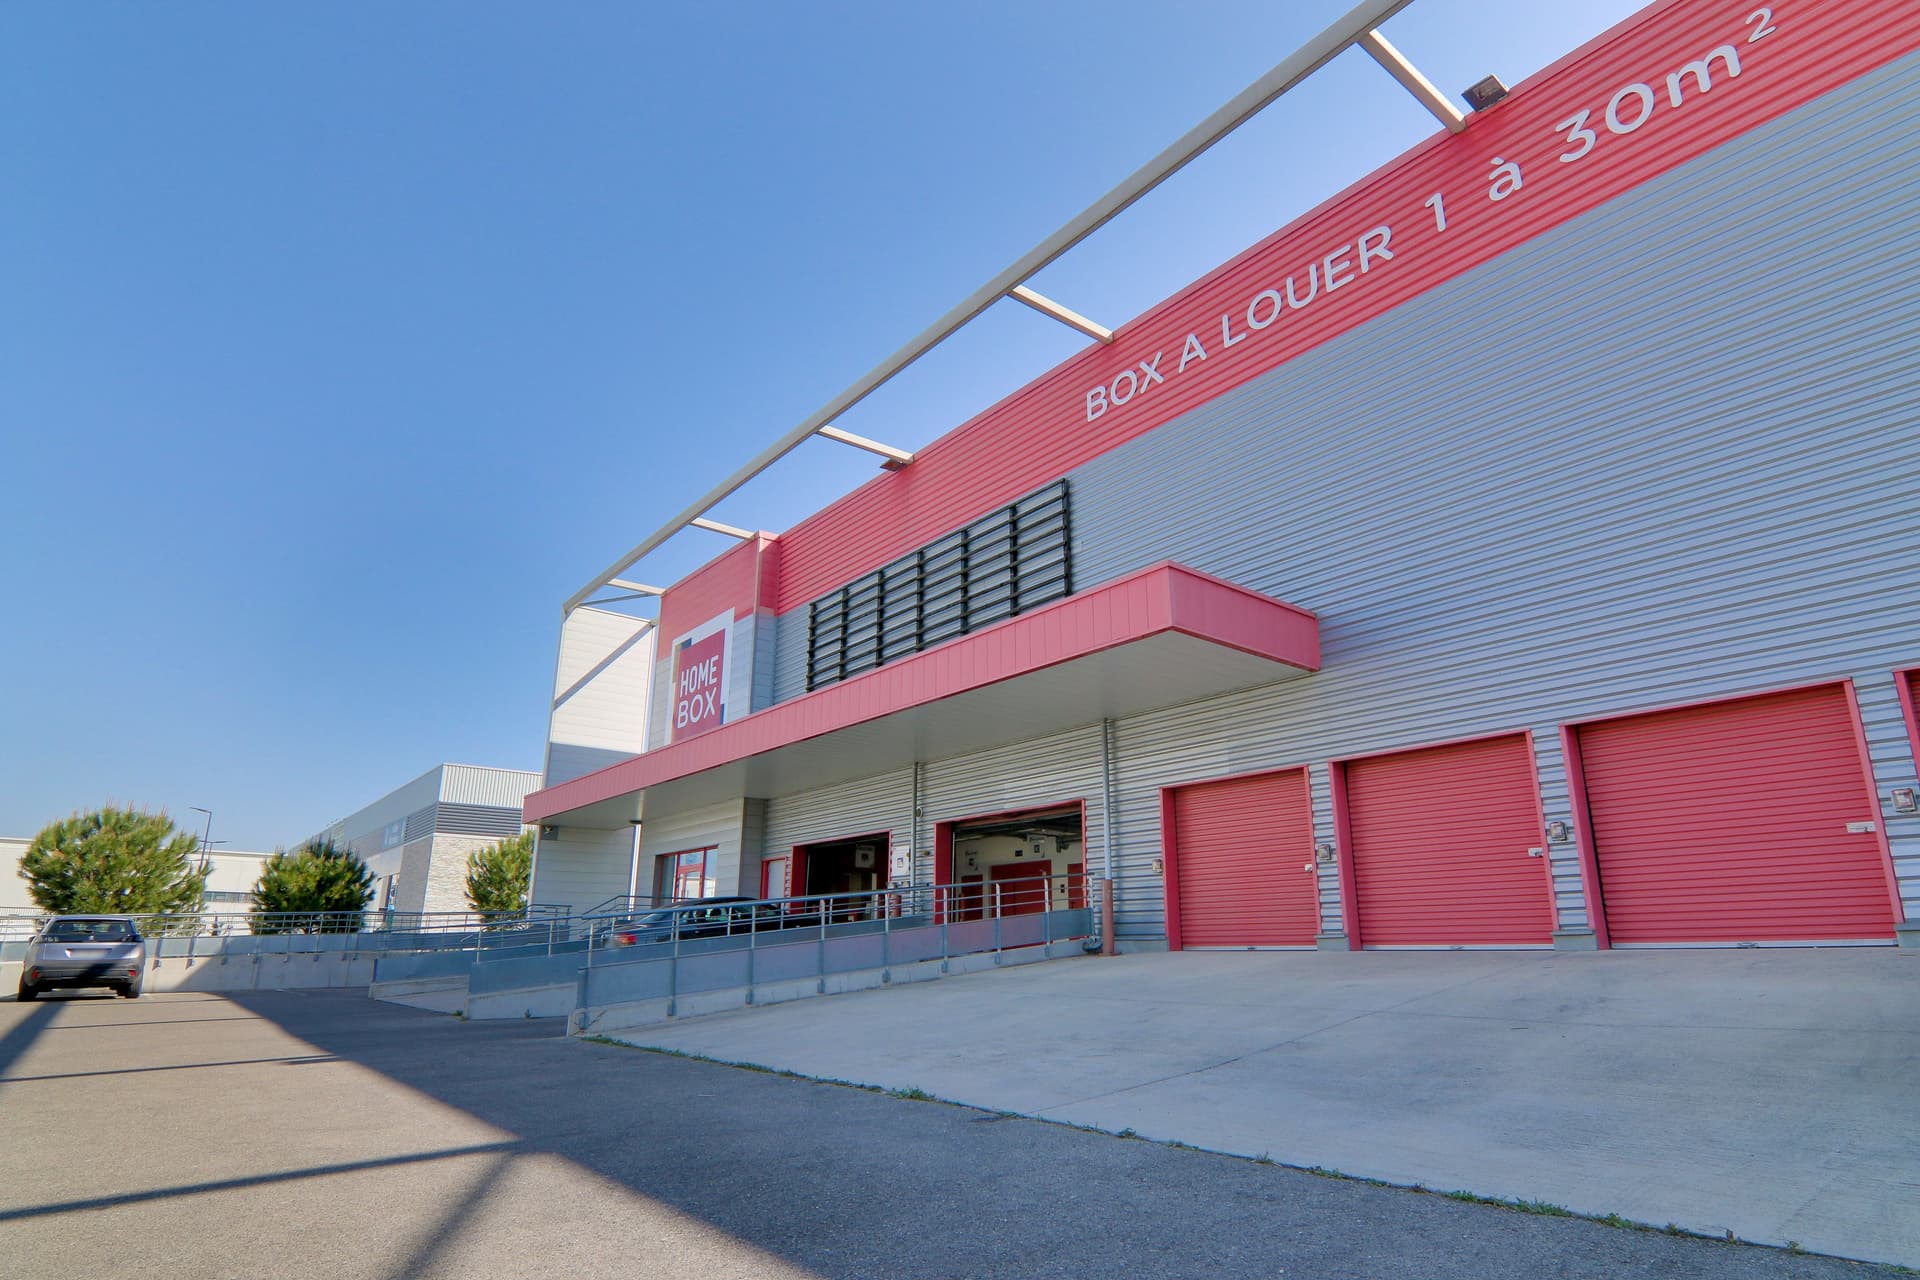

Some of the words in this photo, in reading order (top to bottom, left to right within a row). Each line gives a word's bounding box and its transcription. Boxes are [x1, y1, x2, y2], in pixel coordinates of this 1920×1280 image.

[1086, 351, 1164, 422] BOX
[1178, 333, 1208, 374] A
[1222, 225, 1395, 348] LOUER
[1424, 192, 1447, 233] 1
[1488, 156, 1523, 201] à
[680, 654, 719, 698] HOME
[677, 687, 717, 729] BOX
